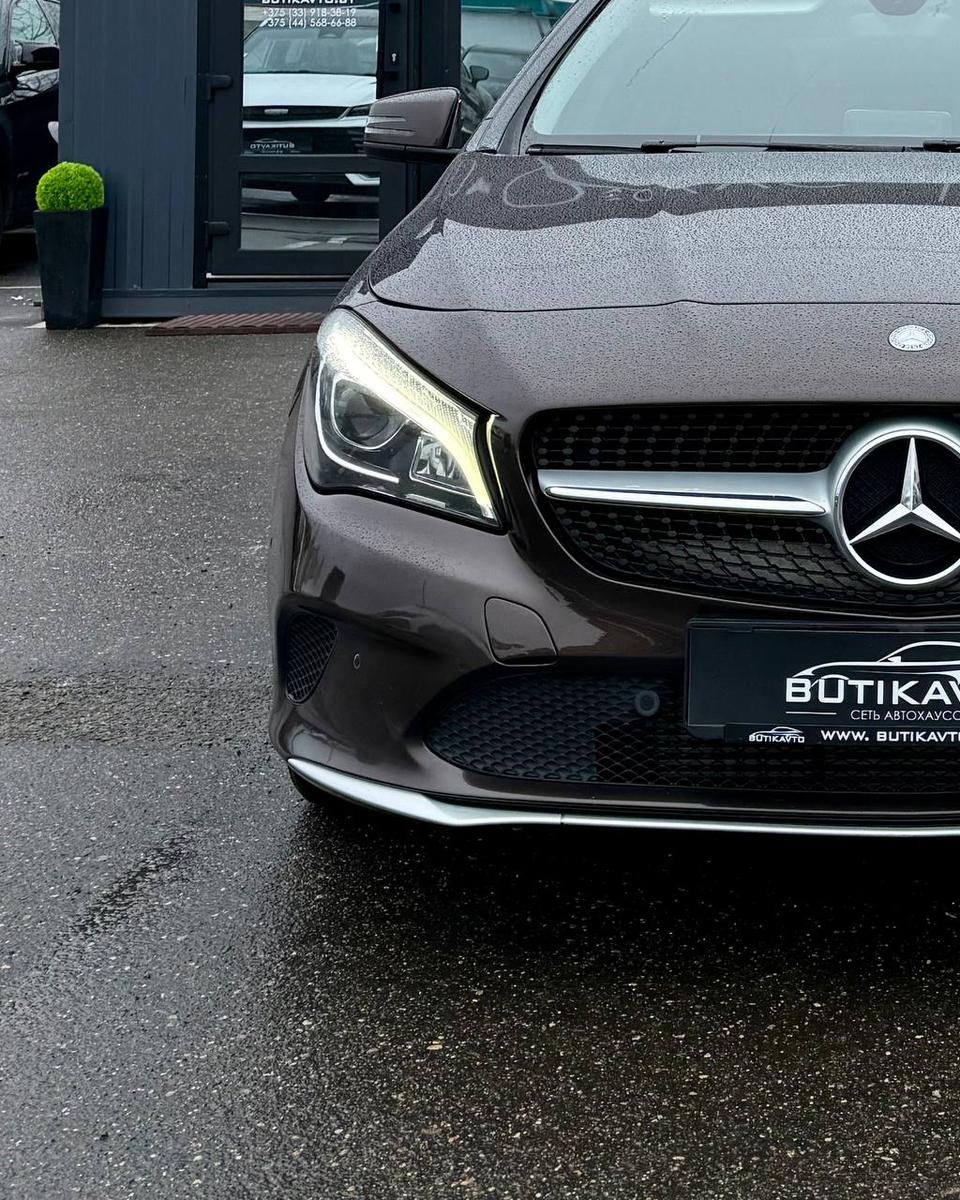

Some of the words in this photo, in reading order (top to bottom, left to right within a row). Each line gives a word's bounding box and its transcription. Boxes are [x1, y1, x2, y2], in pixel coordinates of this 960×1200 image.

[289, 8, 307, 19] (33)
[310, 8, 357, 17] 918-38-19
[289, 18, 307, 29] (44)
[310, 18, 357, 27] 568-66-88
[850, 709, 880, 721] СЕТЬ
[748, 733, 805, 744] BUTIKAVTO
[820, 729, 870, 742] WWW.
